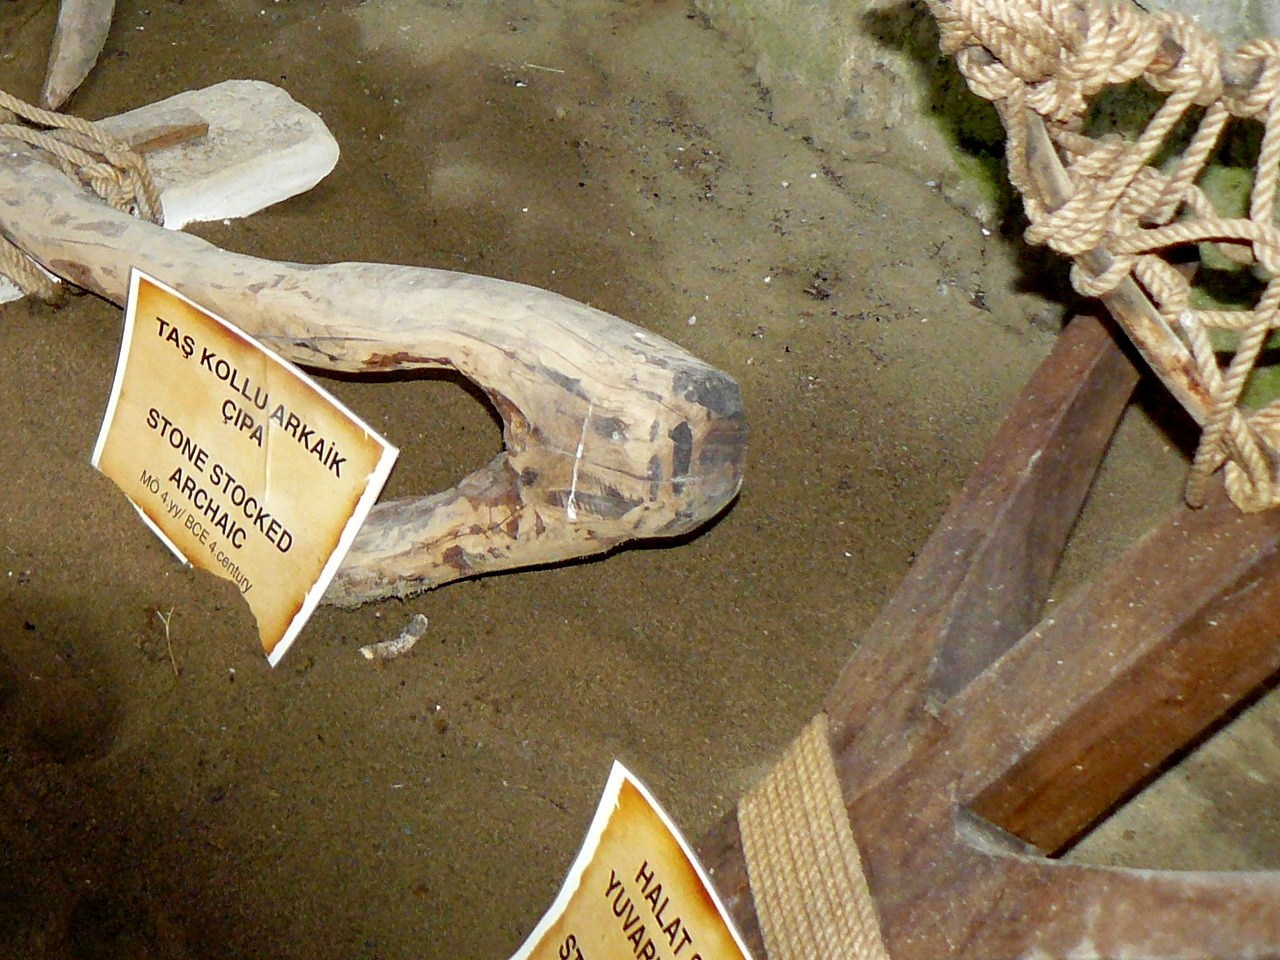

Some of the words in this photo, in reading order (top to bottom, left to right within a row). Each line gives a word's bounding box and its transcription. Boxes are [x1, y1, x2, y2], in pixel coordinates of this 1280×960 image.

[155, 316, 196, 359] TAŞ
[200, 347, 271, 411] KOLLU
[270, 407, 349, 479] ARKAİK
[221, 398, 265, 448] ÇIPA
[139, 469, 161, 495] MÖ
[184, 514, 211, 546] BCE
[146, 407, 208, 471] STONE
[209, 463, 294, 555] STOCKED
[168, 466, 248, 551] ARCHAIC
[604, 869, 661, 960] YUVAR
[634, 860, 693, 954] HALAT
